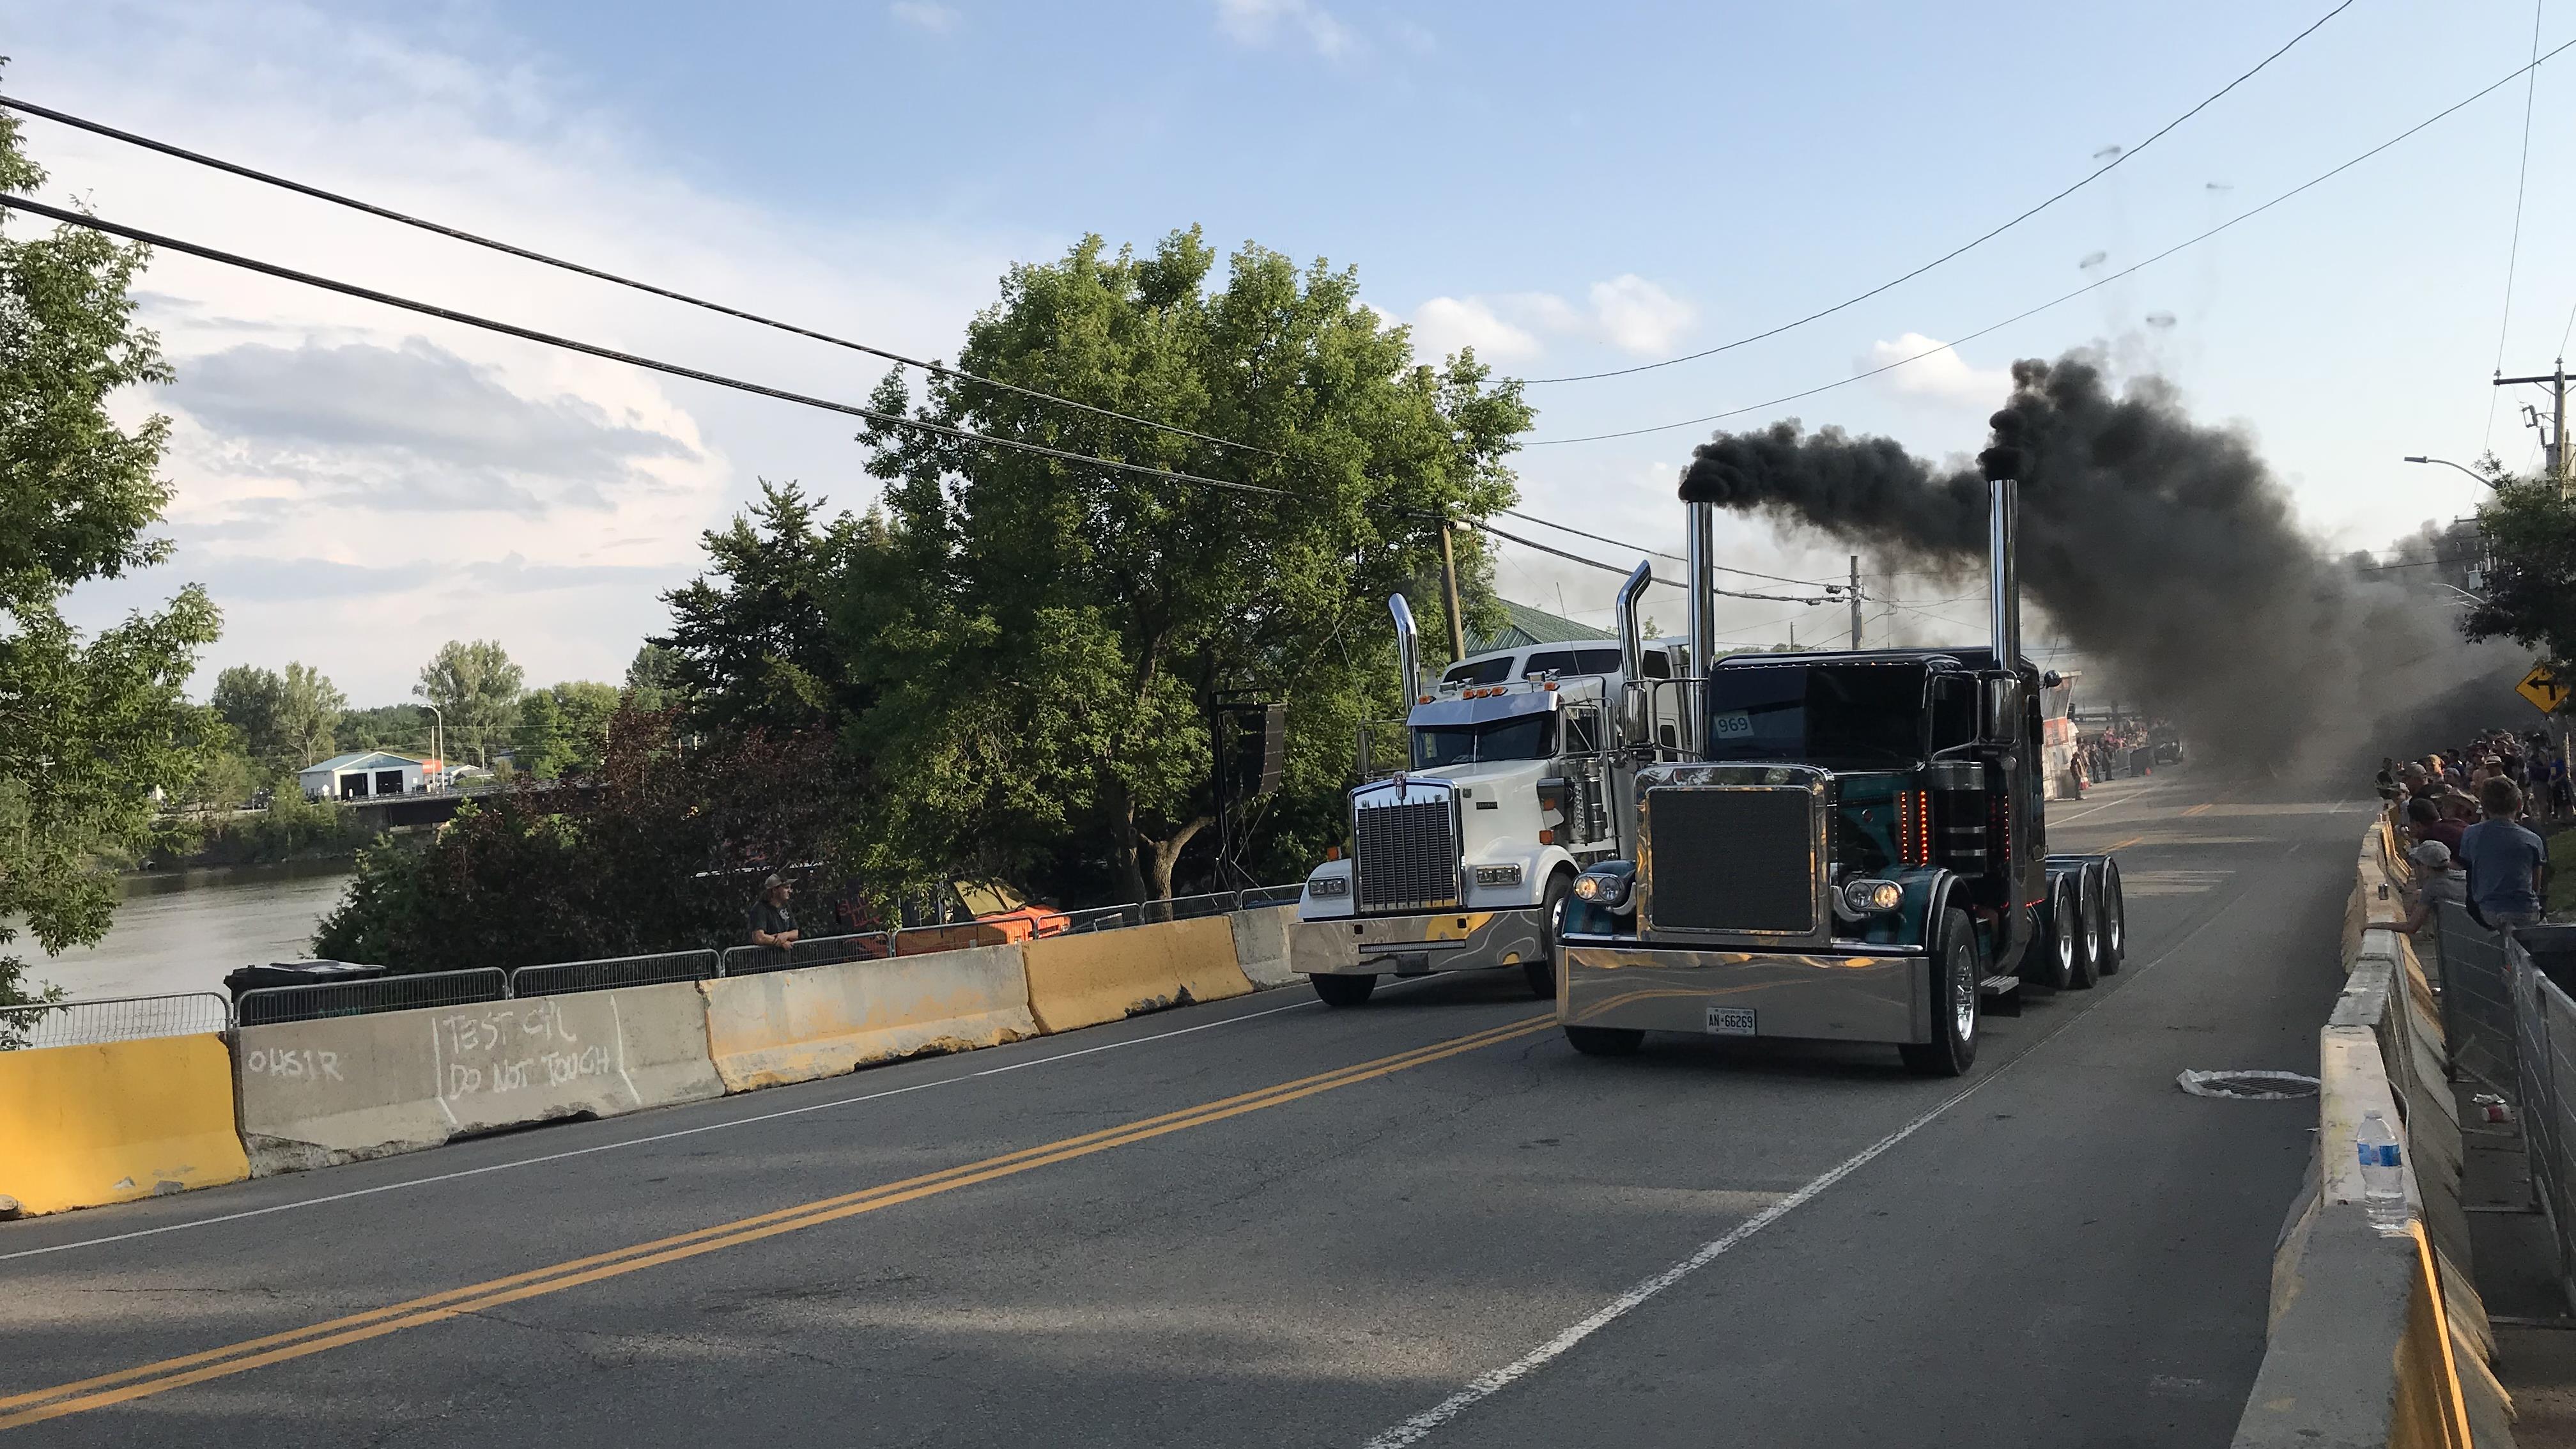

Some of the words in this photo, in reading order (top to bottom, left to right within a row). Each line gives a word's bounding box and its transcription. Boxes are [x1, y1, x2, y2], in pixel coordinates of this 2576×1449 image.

[1718, 717, 1748, 732] 969
[443, 1011, 513, 1054] TEST
[1725, 1015, 1752, 1028] 66269
[449, 1063, 482, 1100] DO
[493, 1058, 534, 1093] NOT
[541, 1046, 610, 1087] TOUCH
